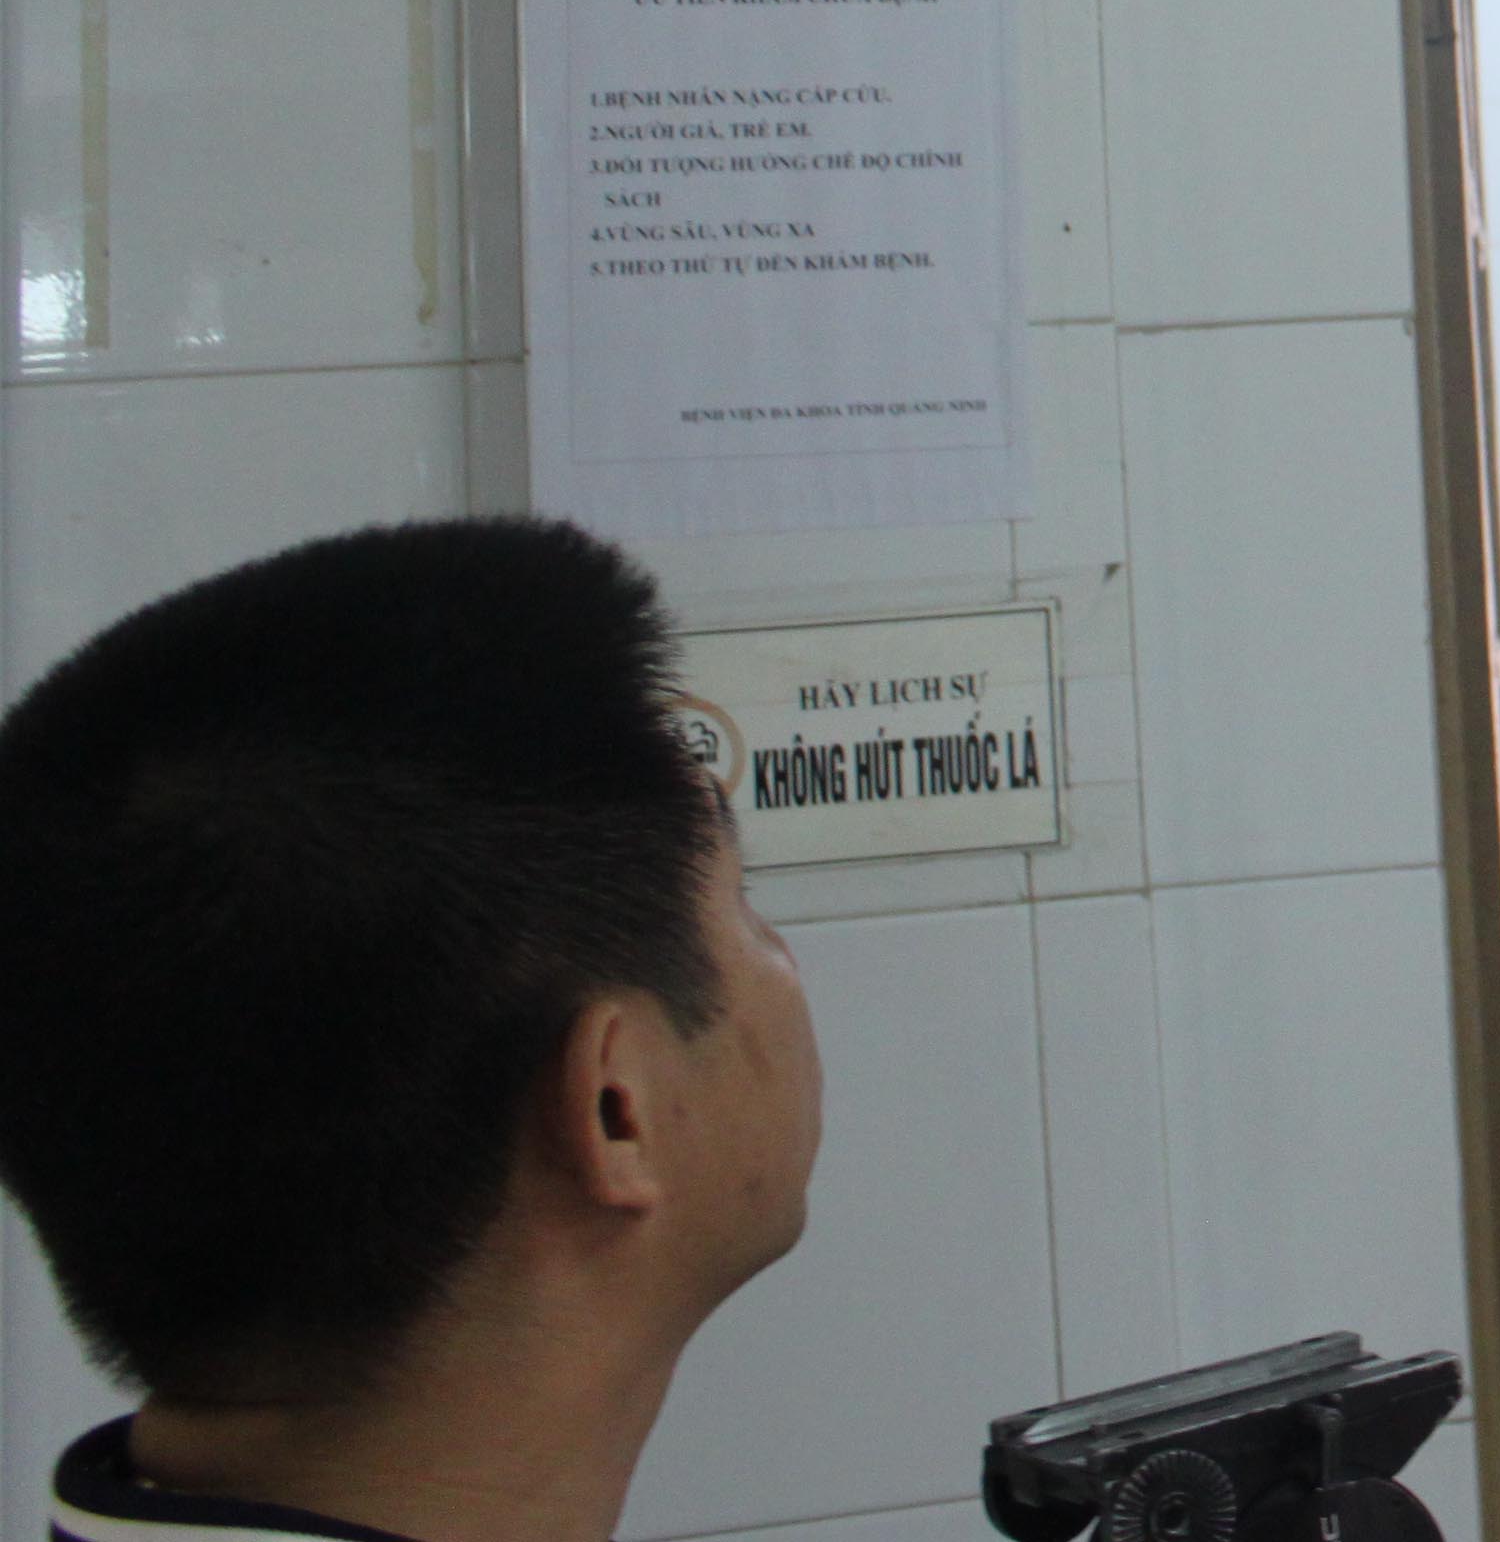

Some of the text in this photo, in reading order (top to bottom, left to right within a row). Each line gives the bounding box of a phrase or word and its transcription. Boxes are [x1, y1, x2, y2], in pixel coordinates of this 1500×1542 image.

[799, 677, 861, 711] HÃY
[870, 675, 942, 714] LỊCH
[753, 710, 1041, 810] KHÔNG HÚT THUỐC LÁ
